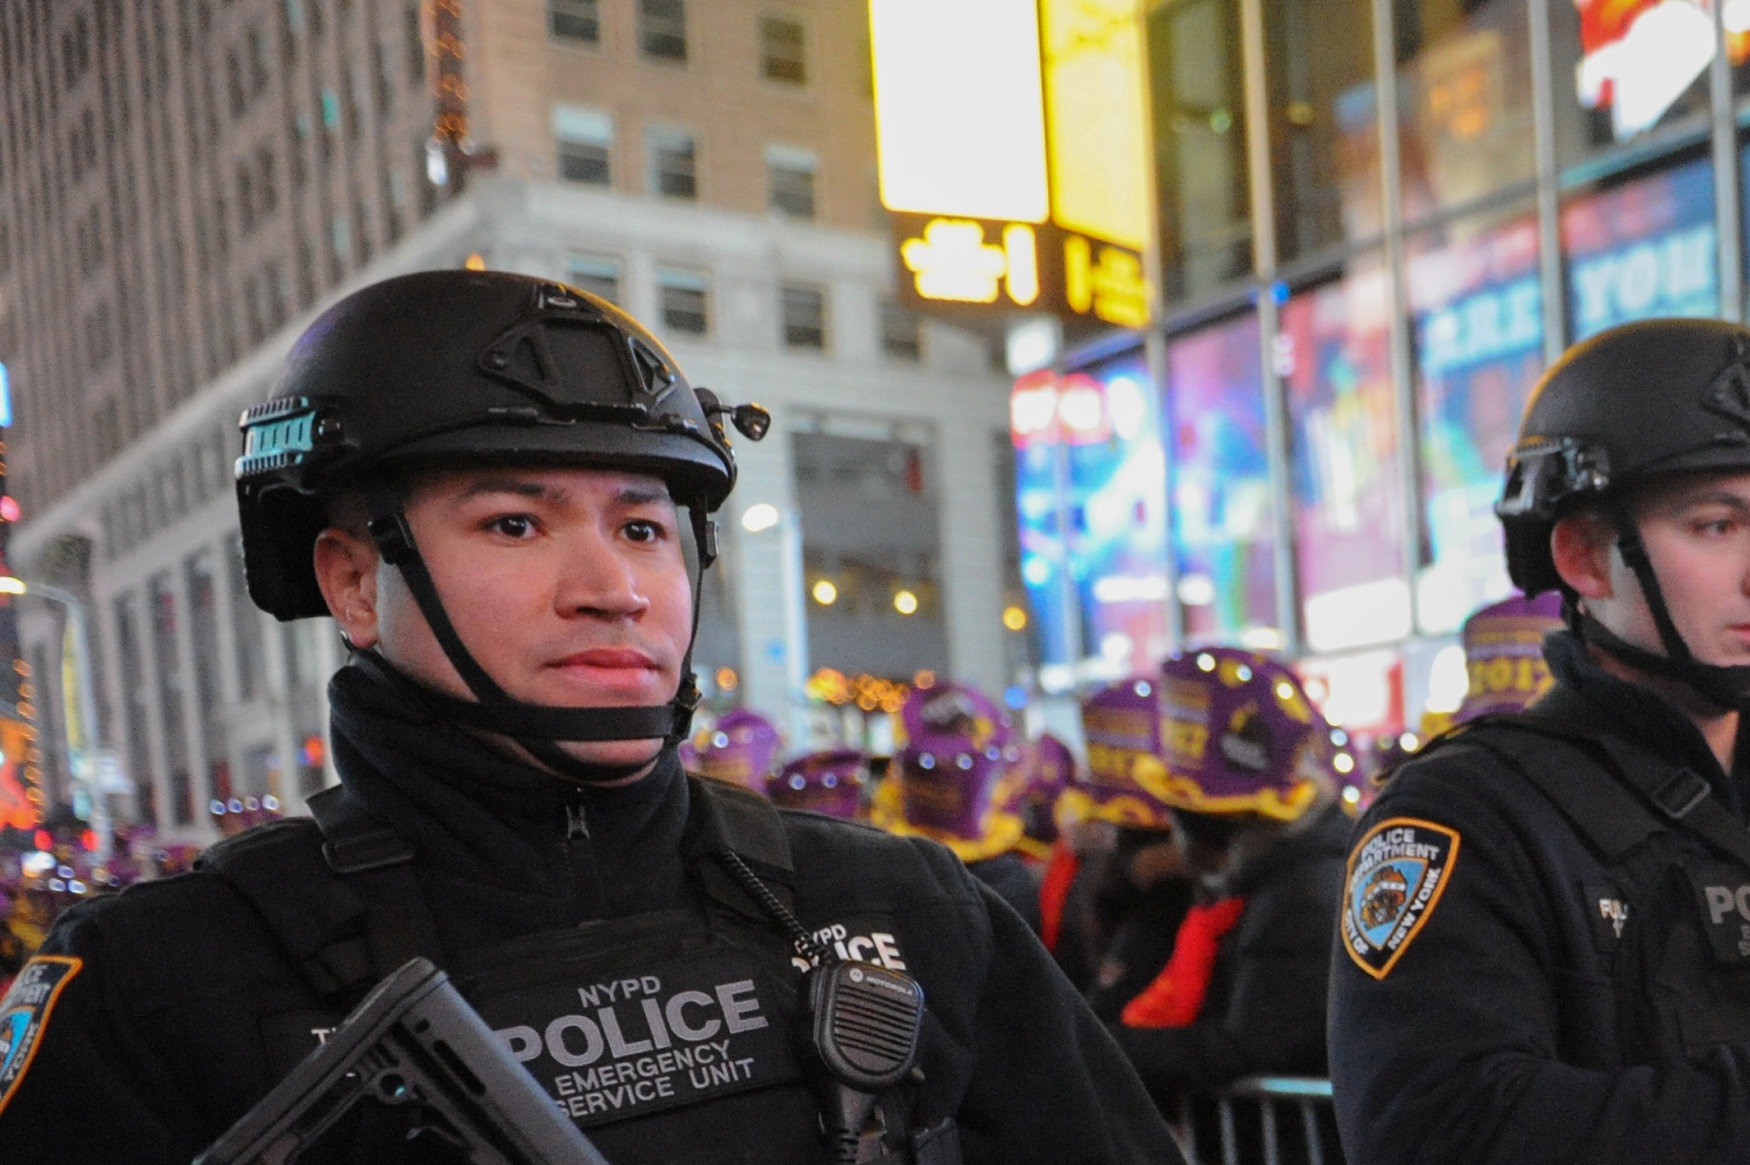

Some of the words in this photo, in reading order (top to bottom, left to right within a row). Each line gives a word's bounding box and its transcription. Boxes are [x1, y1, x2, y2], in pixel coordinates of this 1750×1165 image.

[1387, 912, 1417, 951] NEW
[1410, 867, 1441, 911] YORK
[577, 975, 661, 1008] NYPD
[492, 979, 769, 1067] POLICE
[555, 1039, 731, 1096] EMERGENCY
[689, 1057, 755, 1090] UNIT
